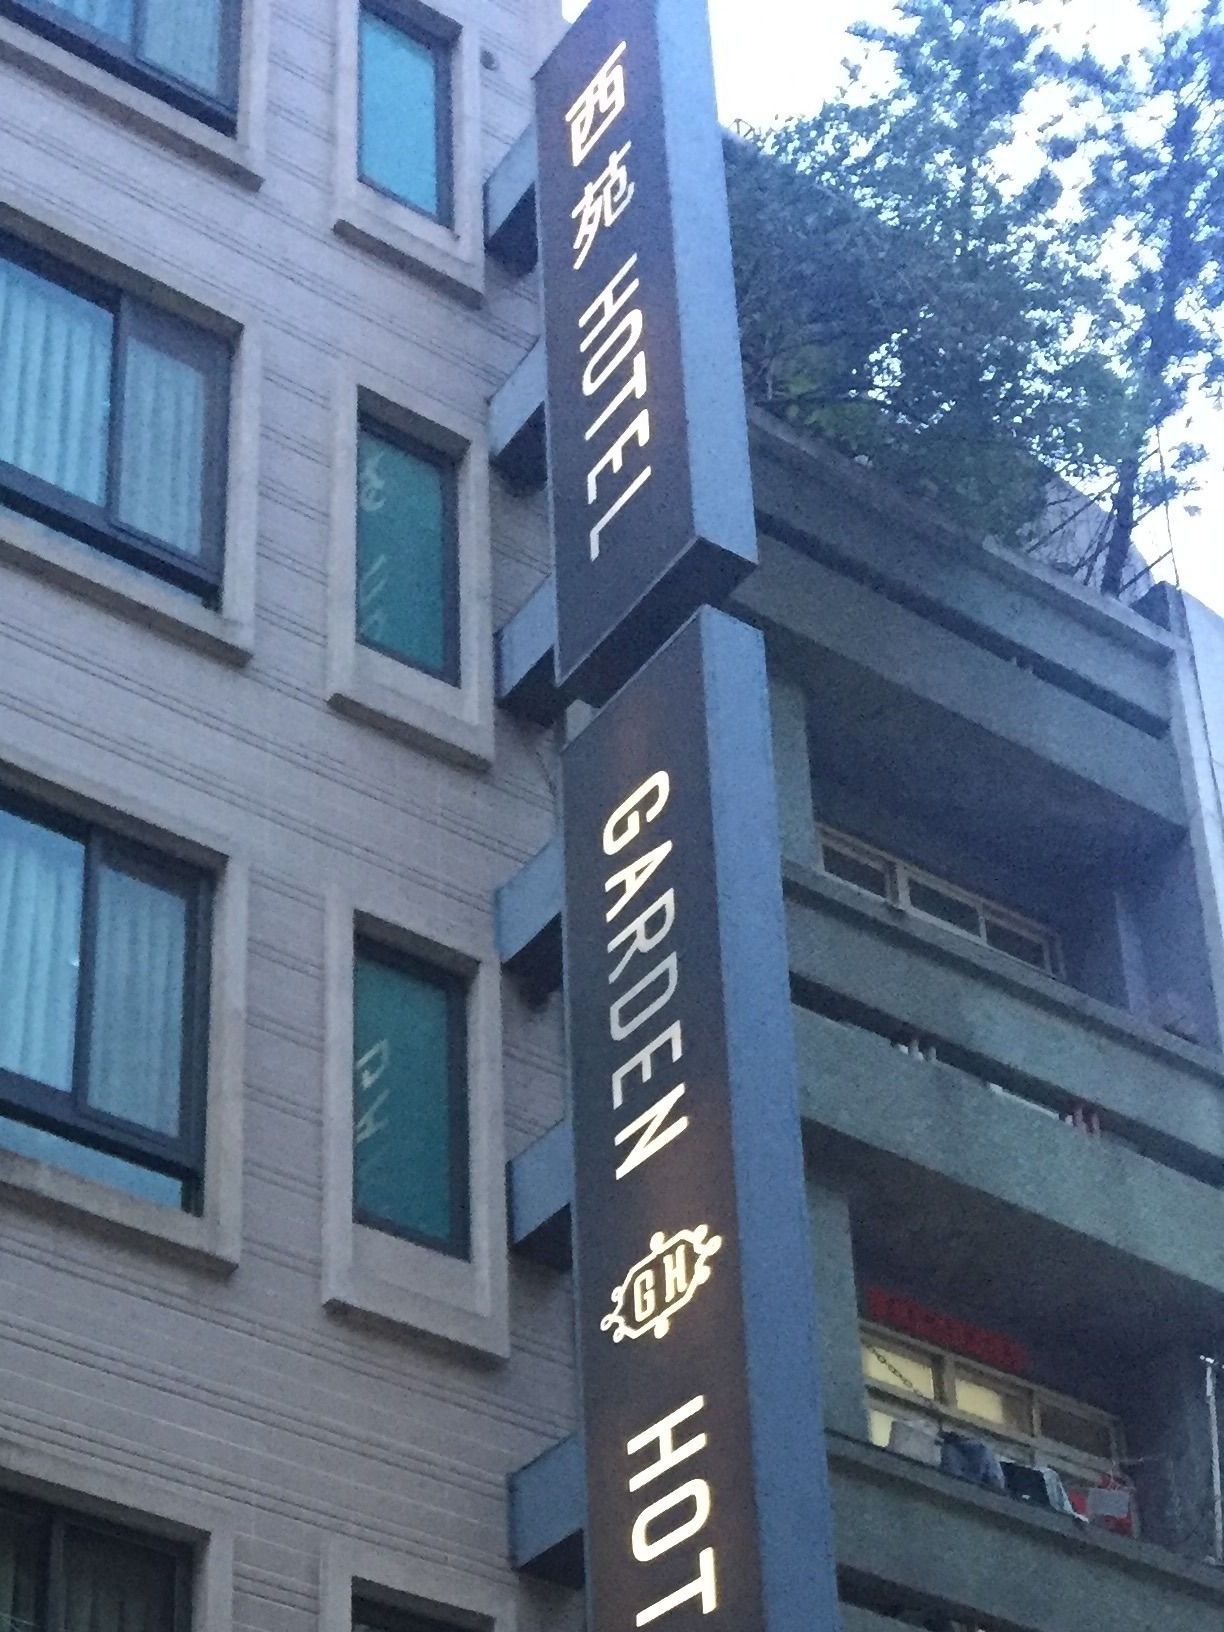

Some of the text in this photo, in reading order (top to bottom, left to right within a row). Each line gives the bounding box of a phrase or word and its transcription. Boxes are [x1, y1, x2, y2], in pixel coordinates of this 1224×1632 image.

[565, 41, 635, 270] 西苑
[578, 253, 652, 561] HOTEL
[603, 771, 689, 1180] GARDEN
